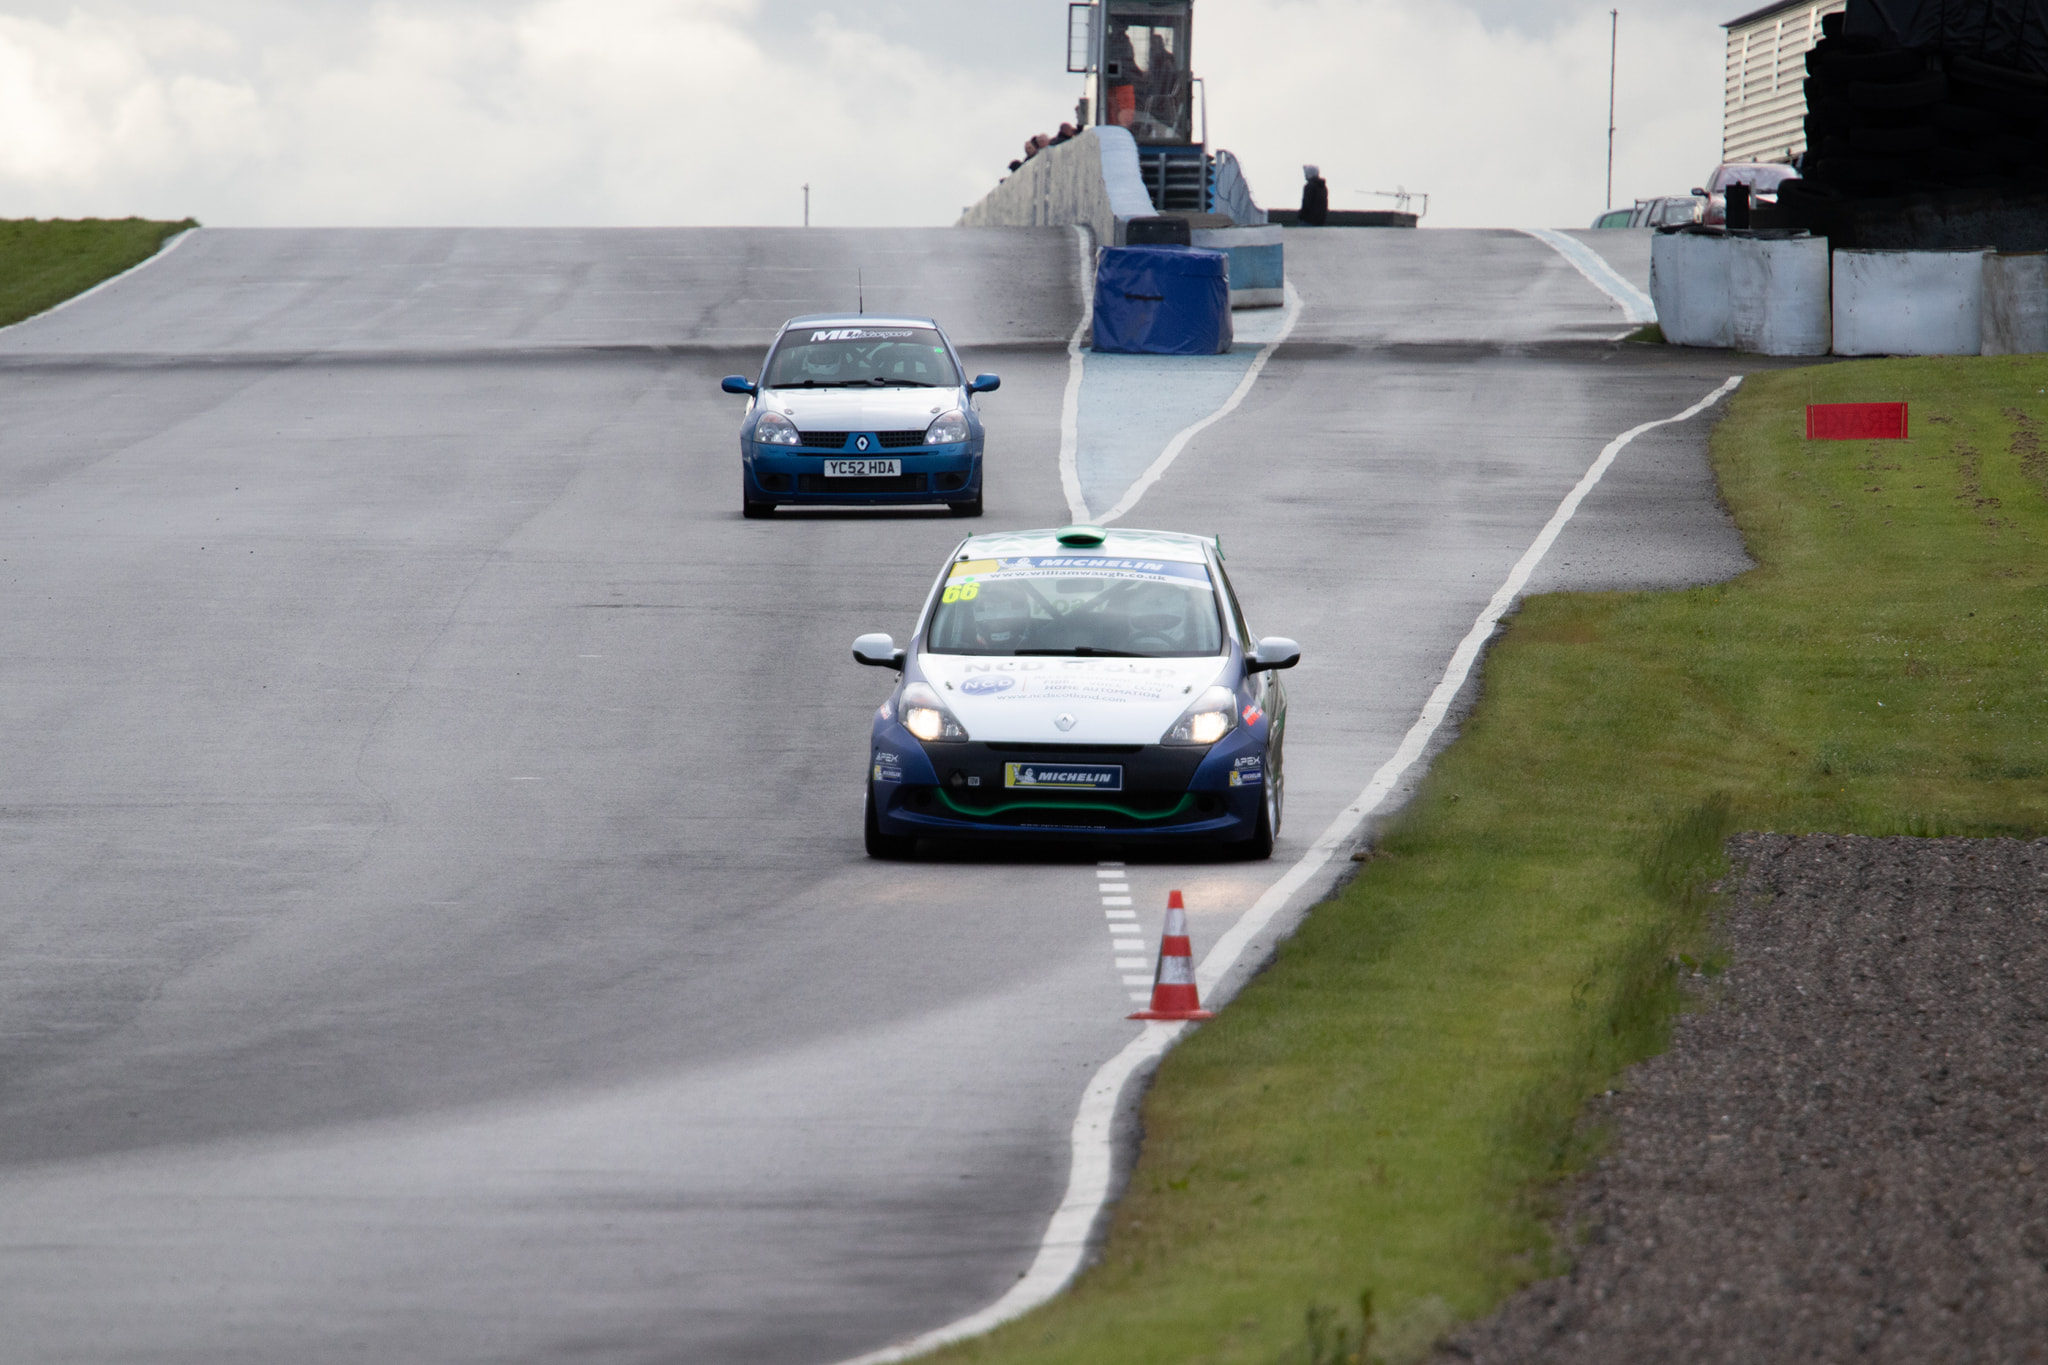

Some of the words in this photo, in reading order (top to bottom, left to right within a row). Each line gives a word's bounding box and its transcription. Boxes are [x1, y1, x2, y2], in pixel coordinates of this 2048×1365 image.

[830, 461, 865, 474] YC52
[868, 461, 895, 474] HDA
[1039, 559, 1164, 571] MICHELIN
[990, 570, 1166, 581] www.williamwaugh.co.uk
[942, 582, 980, 604] 66
[964, 661, 1045, 673] NCD
[964, 679, 1011, 690] NCD
[996, 691, 1127, 703] www.ncdscotland.com
[1083, 687, 1161, 699] AUTOMATION
[876, 752, 899, 762] APEX
[1234, 756, 1260, 766] APEX
[1038, 772, 1112, 782] MICHELIN
